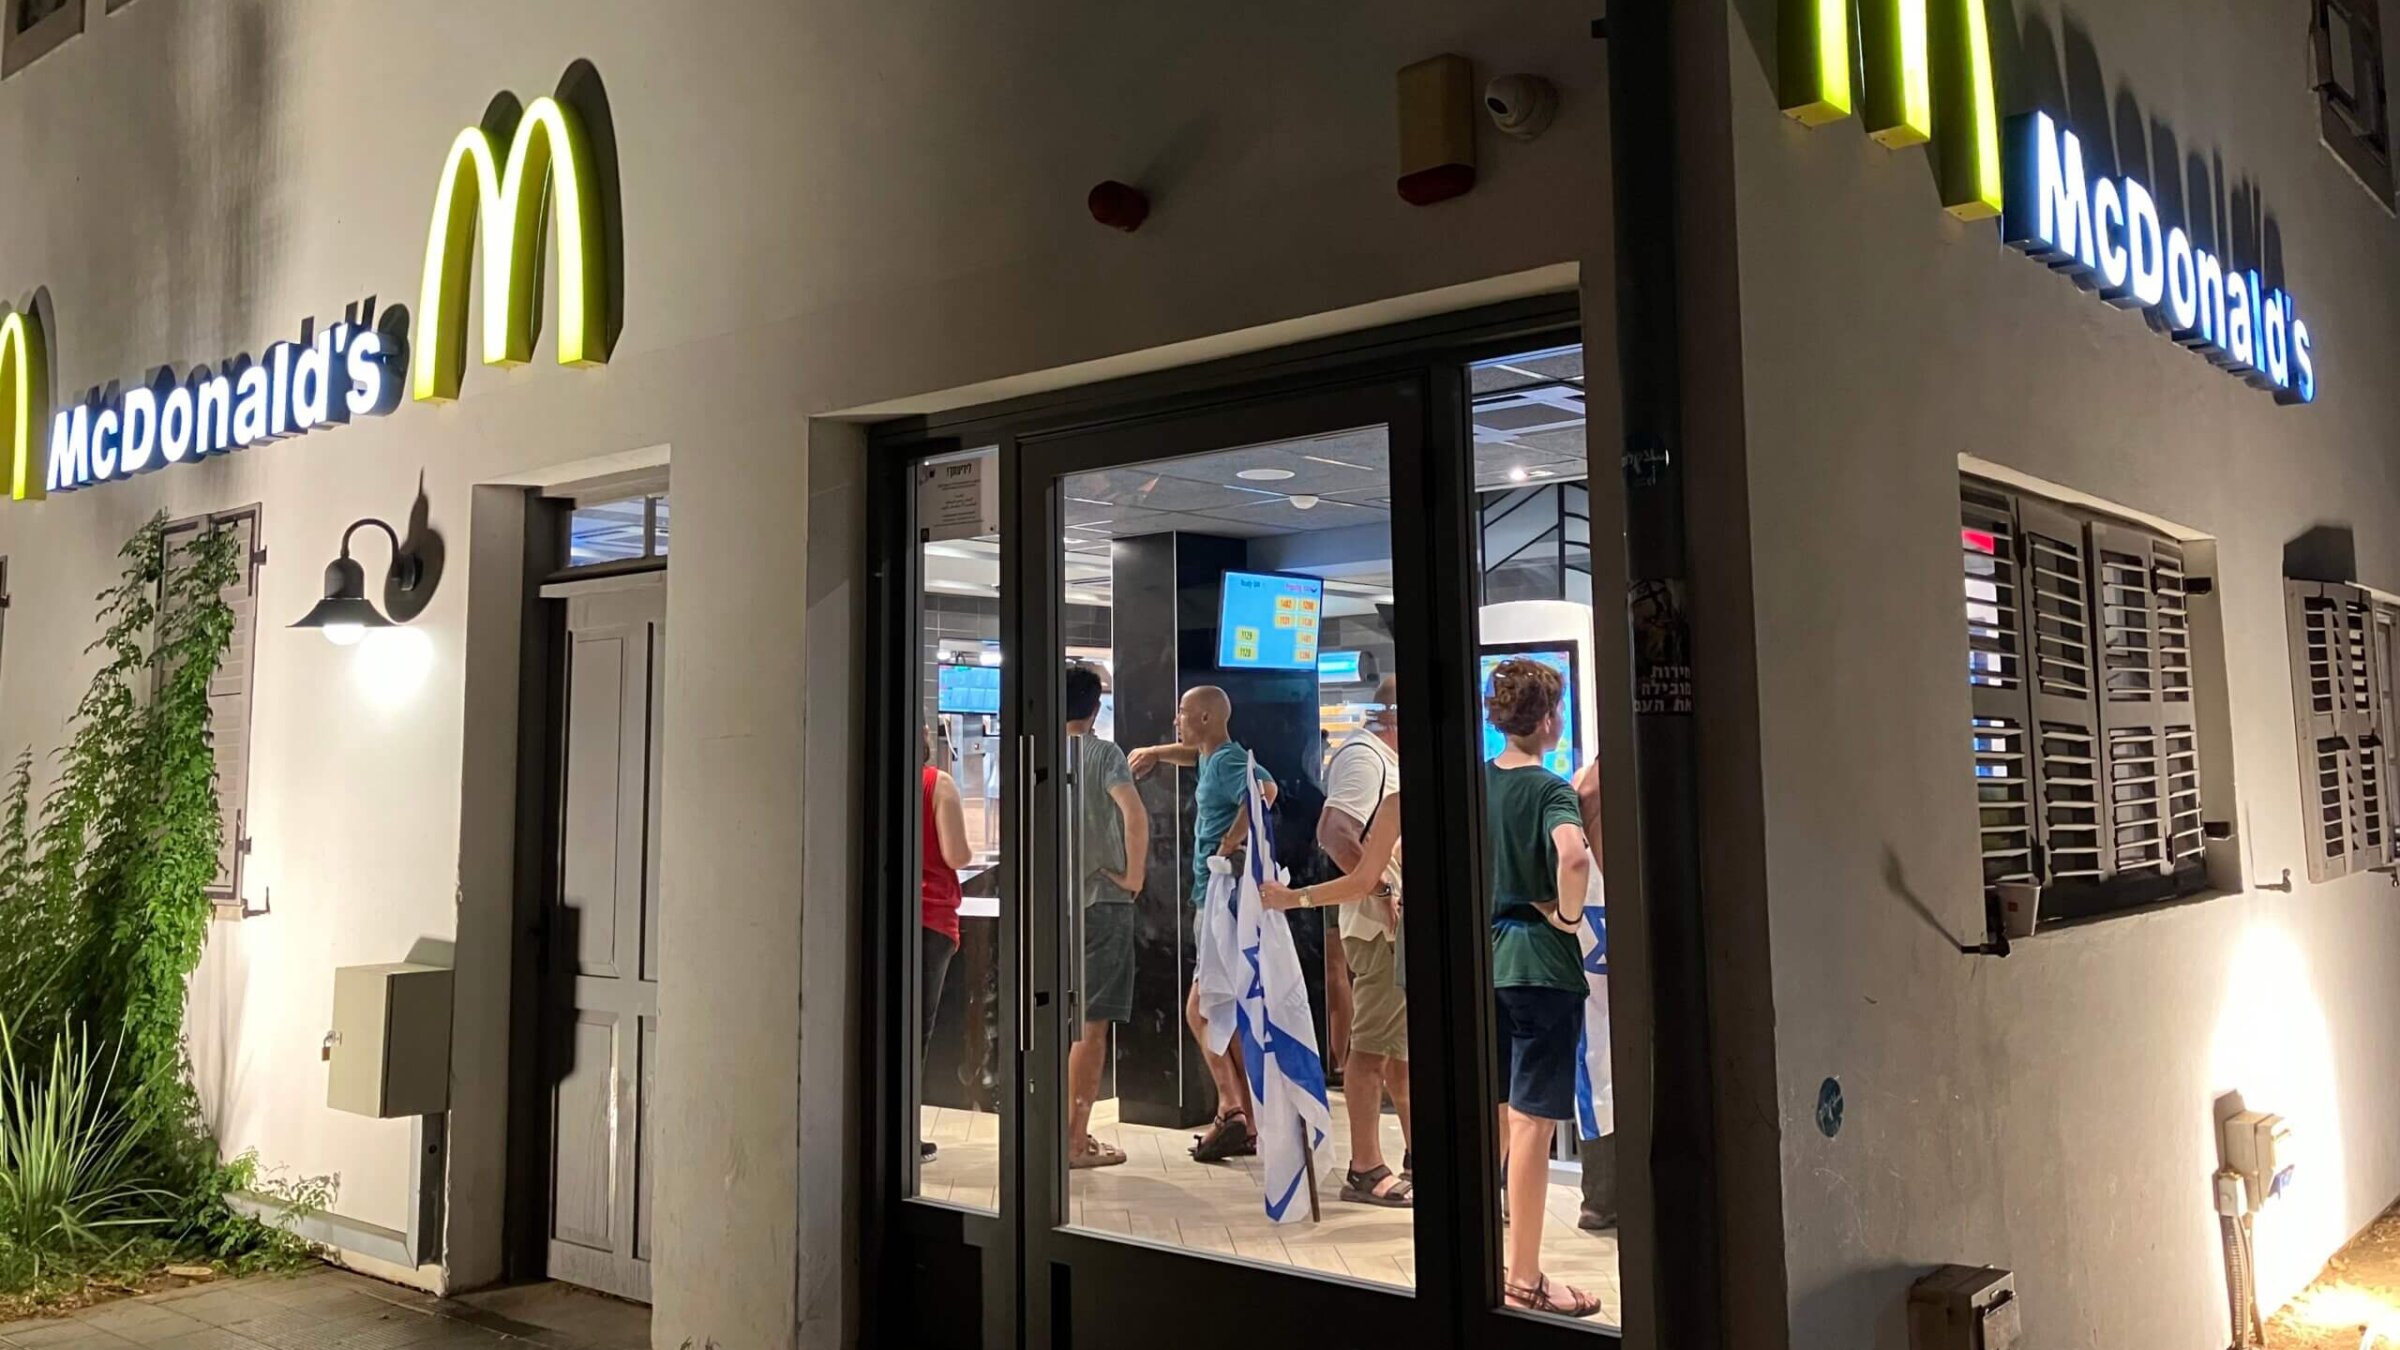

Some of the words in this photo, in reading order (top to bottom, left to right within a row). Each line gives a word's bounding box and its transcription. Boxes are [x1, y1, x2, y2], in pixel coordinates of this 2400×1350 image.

[2036, 110, 2316, 404] McDonald's
[46, 322, 384, 492] McDonald's
[1641, 678, 1692, 695] מובילה
[1673, 698, 1692, 712] את
